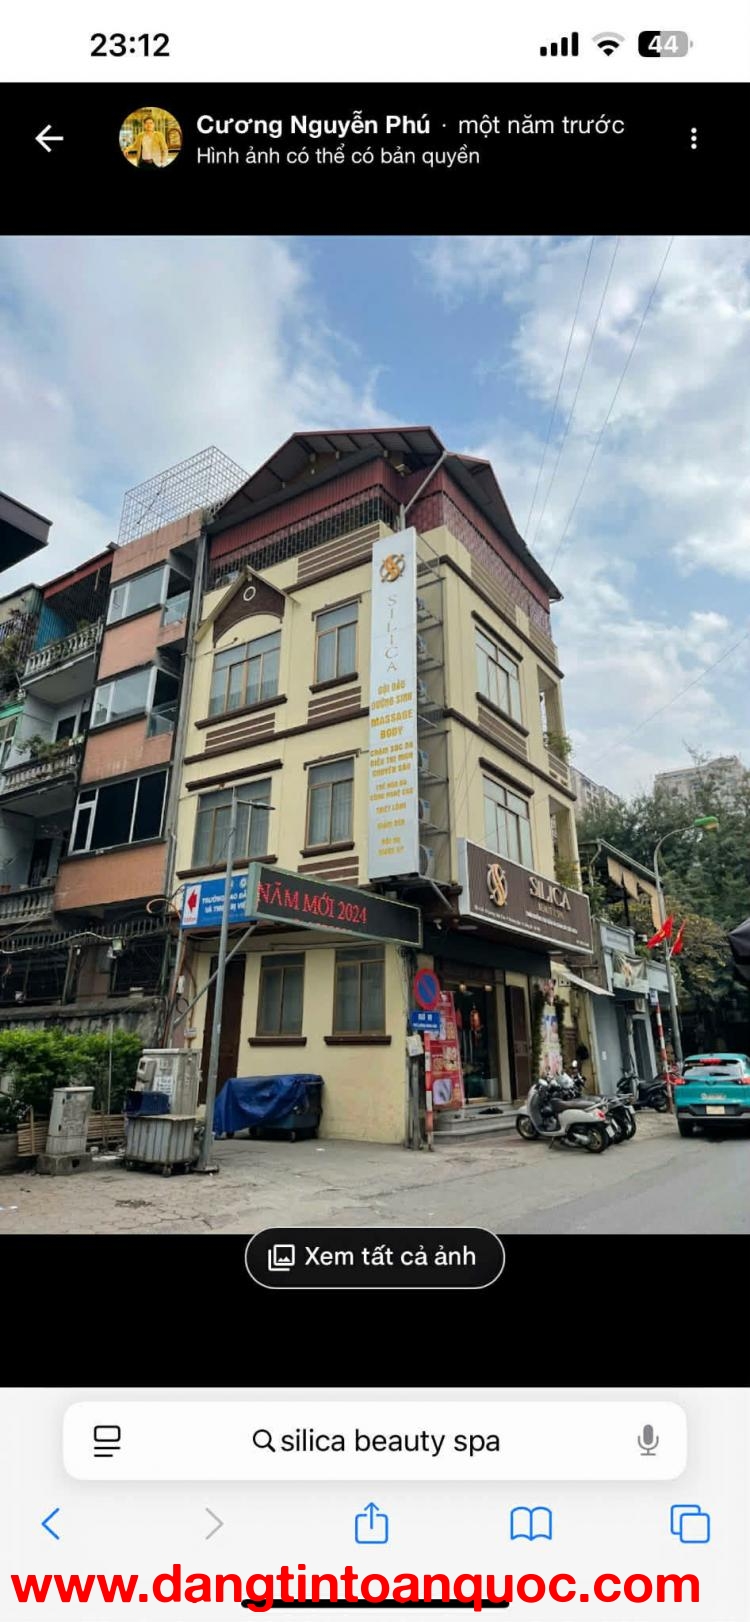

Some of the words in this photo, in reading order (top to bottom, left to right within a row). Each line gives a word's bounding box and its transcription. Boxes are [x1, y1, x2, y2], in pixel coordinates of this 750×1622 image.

[385, 594, 399, 672] SILICA
[371, 709, 414, 728] MASSAGE
[380, 726, 403, 739] BODY
[257, 881, 300, 911] NĂM
[302, 891, 335, 918] MỚI
[337, 901, 368, 925] 2024
[529, 877, 571, 911] SILICA
